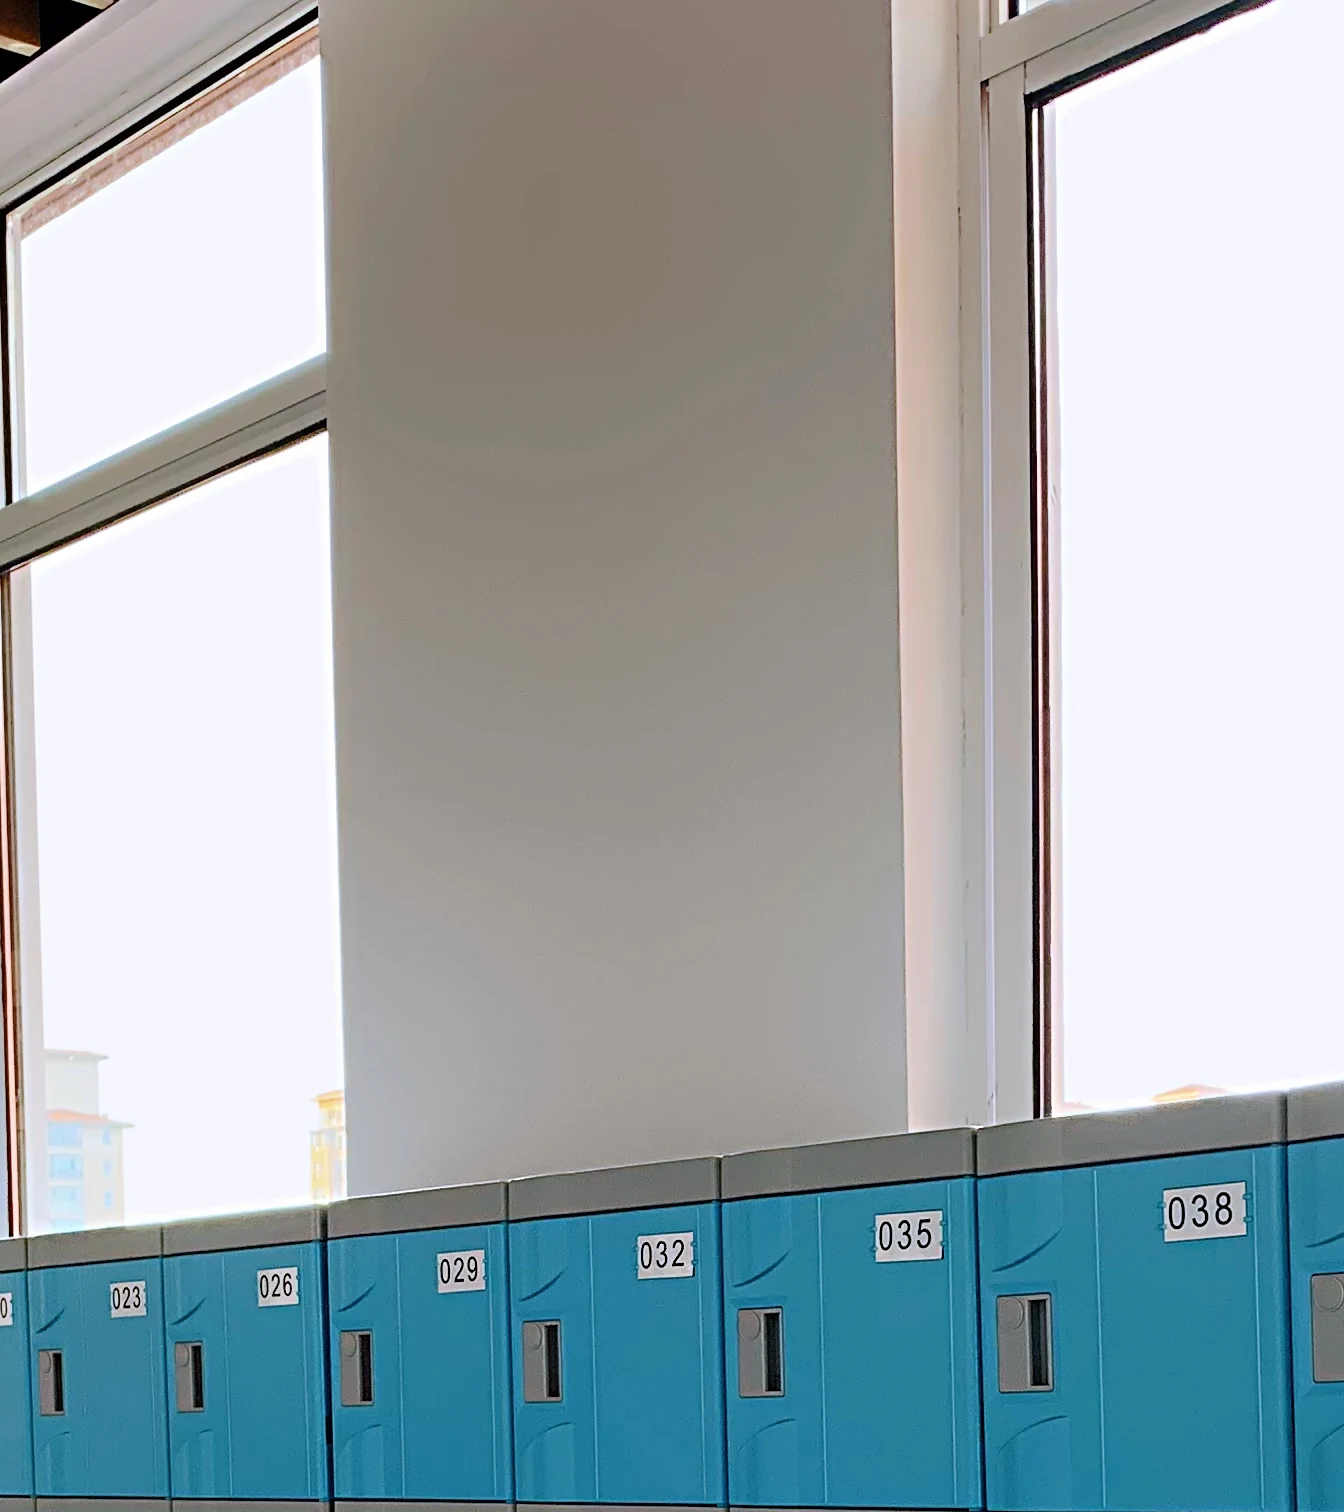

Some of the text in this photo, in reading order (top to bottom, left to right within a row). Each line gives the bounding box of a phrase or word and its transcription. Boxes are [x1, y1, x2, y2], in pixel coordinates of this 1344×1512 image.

[1169, 1192, 1232, 1229] 038
[879, 1219, 931, 1250] 035
[641, 1240, 684, 1269] 032
[440, 1257, 477, 1284] 029
[113, 1286, 140, 1309] 023
[260, 1273, 292, 1298] 026
